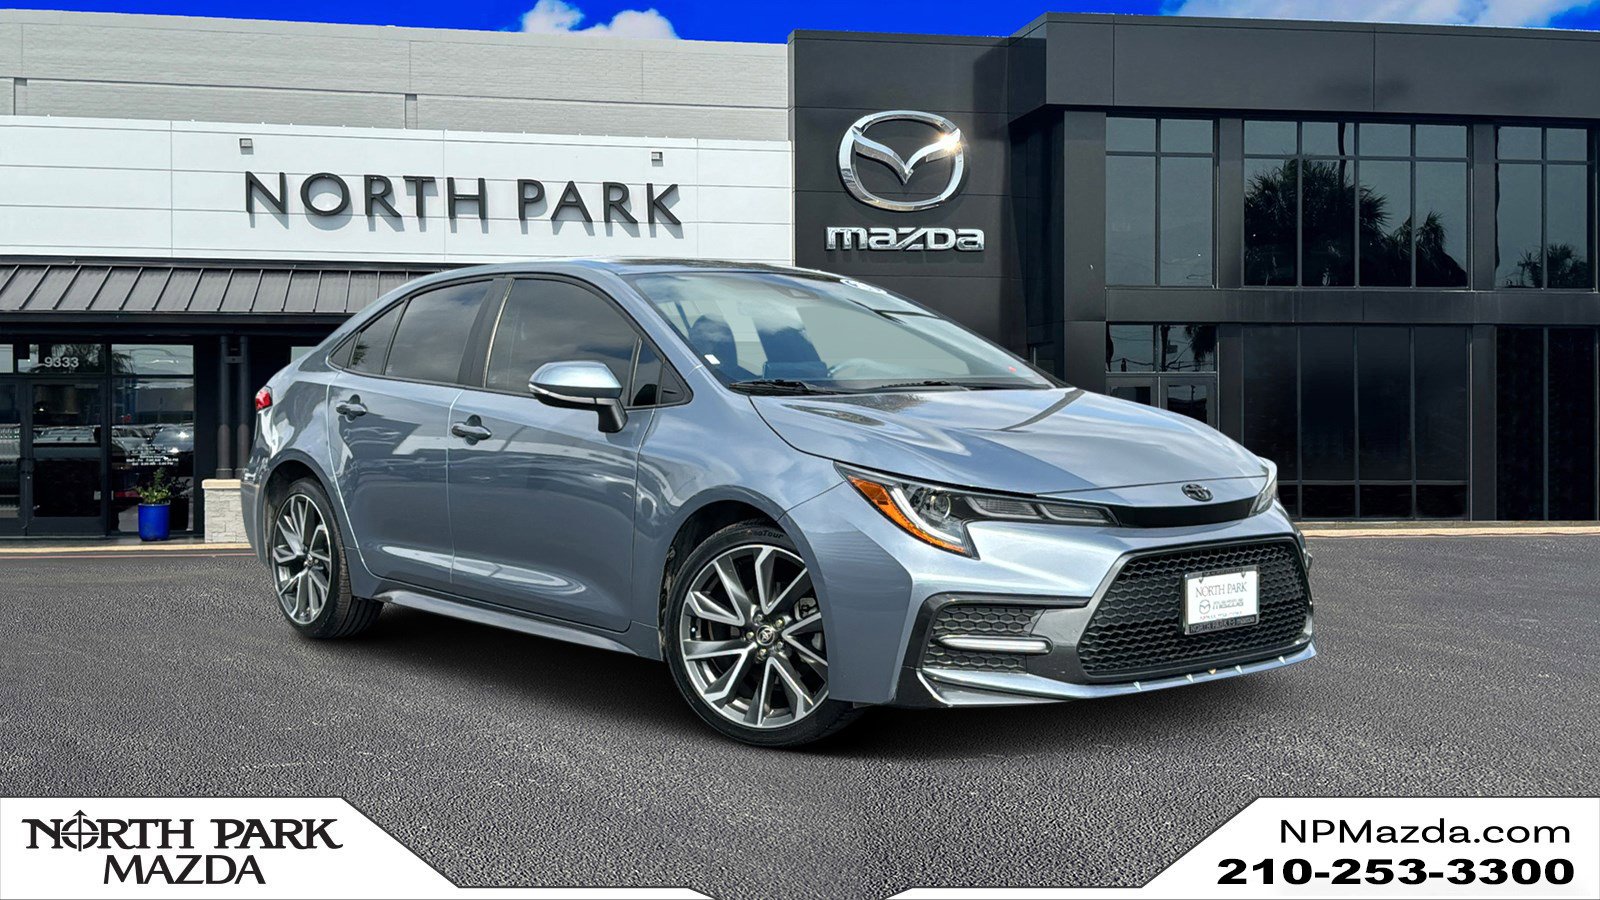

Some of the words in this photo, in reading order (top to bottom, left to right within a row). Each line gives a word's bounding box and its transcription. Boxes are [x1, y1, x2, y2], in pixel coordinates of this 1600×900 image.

[245, 171, 489, 221] NORTH
[517, 179, 682, 226] PARK
[826, 226, 985, 251] mazda
[44, 356, 79, 368] 9333
[1195, 584, 1225, 598] NORTH
[1227, 581, 1247, 594] PARK
